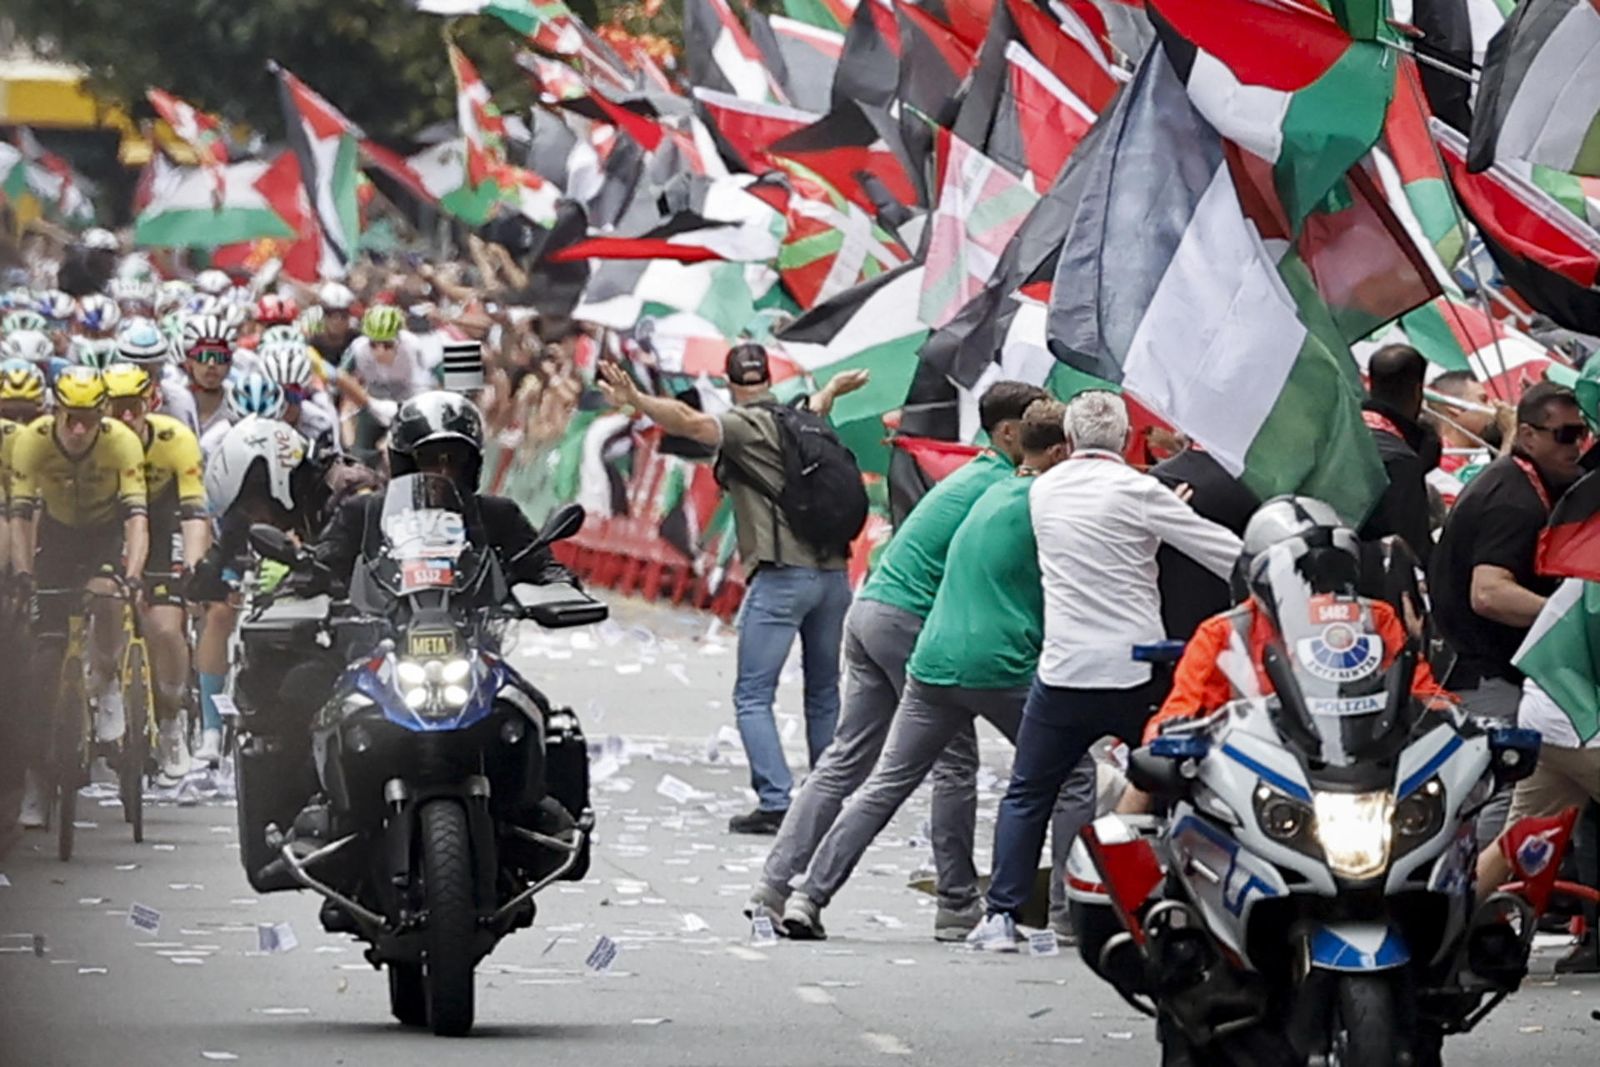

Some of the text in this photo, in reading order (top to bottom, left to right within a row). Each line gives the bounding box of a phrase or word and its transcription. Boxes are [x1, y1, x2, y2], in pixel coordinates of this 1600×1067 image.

[274, 430, 292, 468] rtve
[412, 636, 448, 656] META
[1314, 698, 1379, 712] POLIZIA
